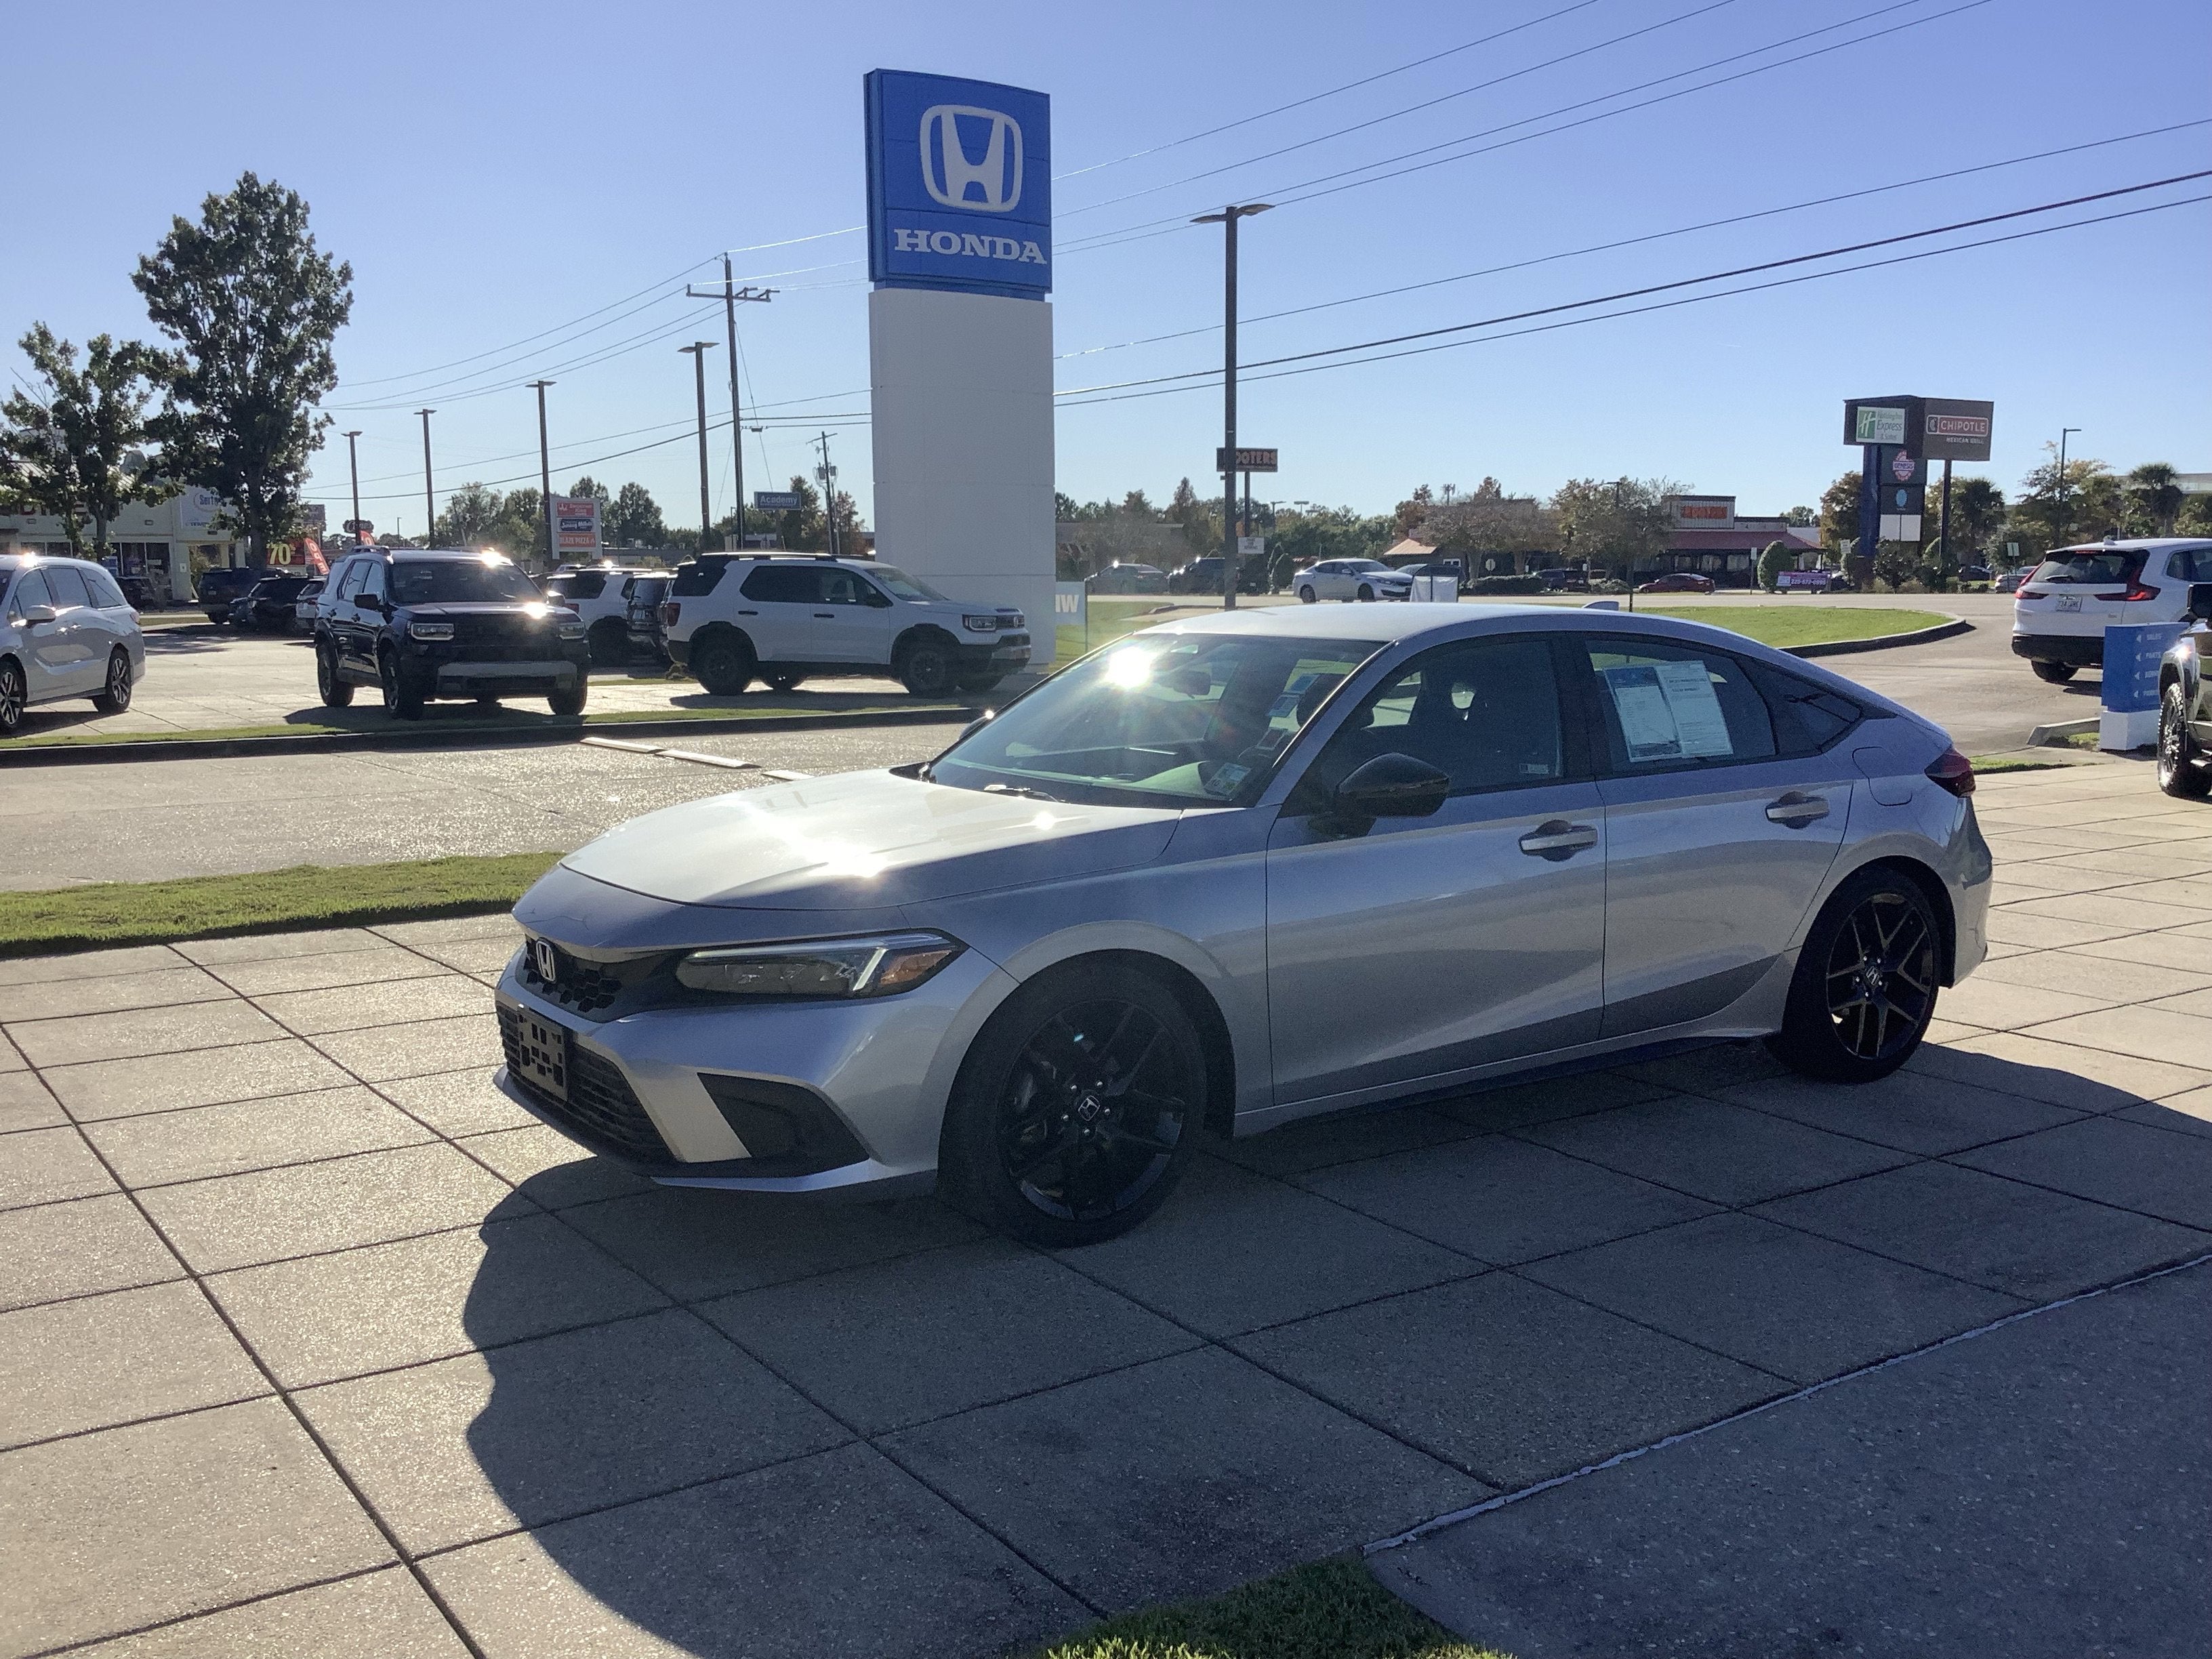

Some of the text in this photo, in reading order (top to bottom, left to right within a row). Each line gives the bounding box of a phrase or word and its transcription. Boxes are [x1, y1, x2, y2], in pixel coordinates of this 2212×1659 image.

[893, 228, 1048, 264] HONDA
[1877, 419, 1902, 432] Express
[1940, 420, 1986, 432] CHIPOTLE
[760, 495, 798, 505] Academy
